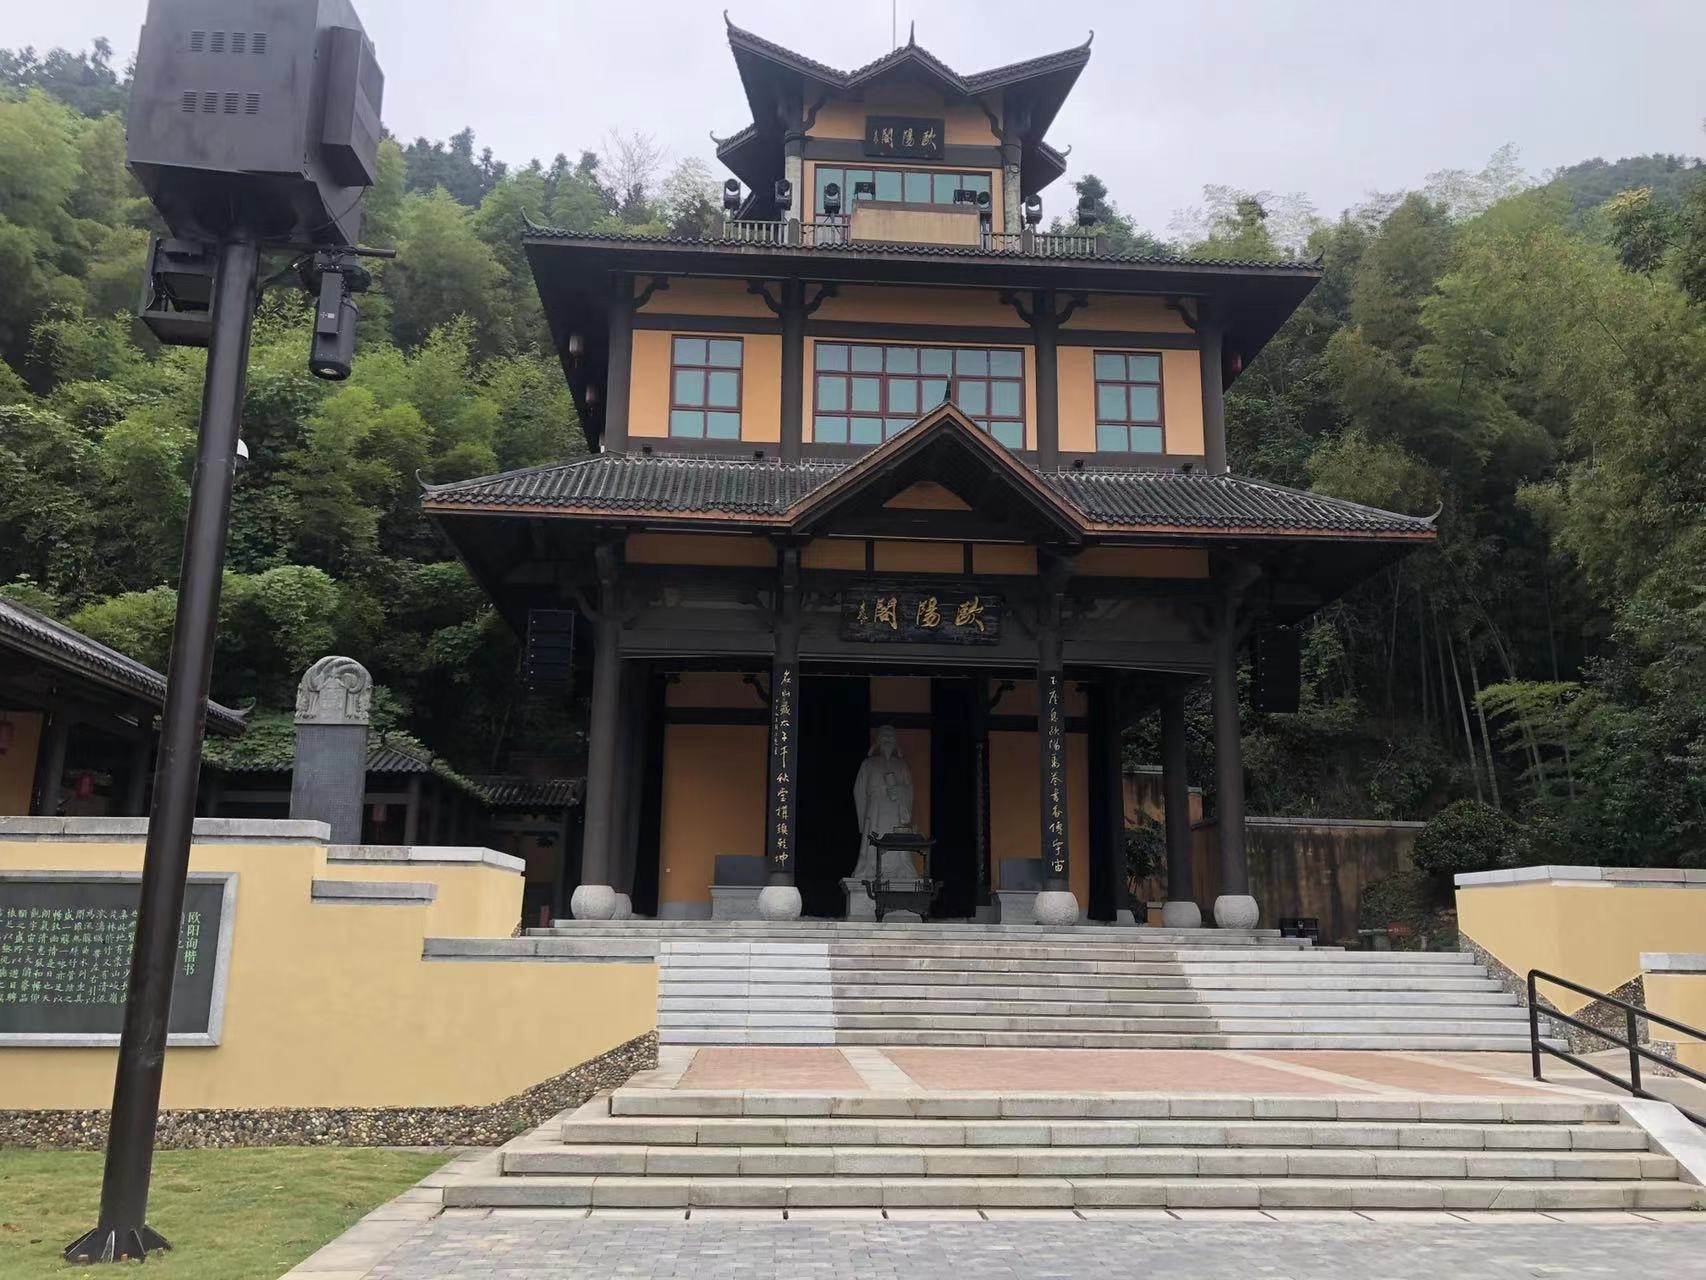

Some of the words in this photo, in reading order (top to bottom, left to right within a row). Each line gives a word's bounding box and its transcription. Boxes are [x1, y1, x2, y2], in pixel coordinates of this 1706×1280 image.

[183, 911, 201, 976] 欧阳询楷书
